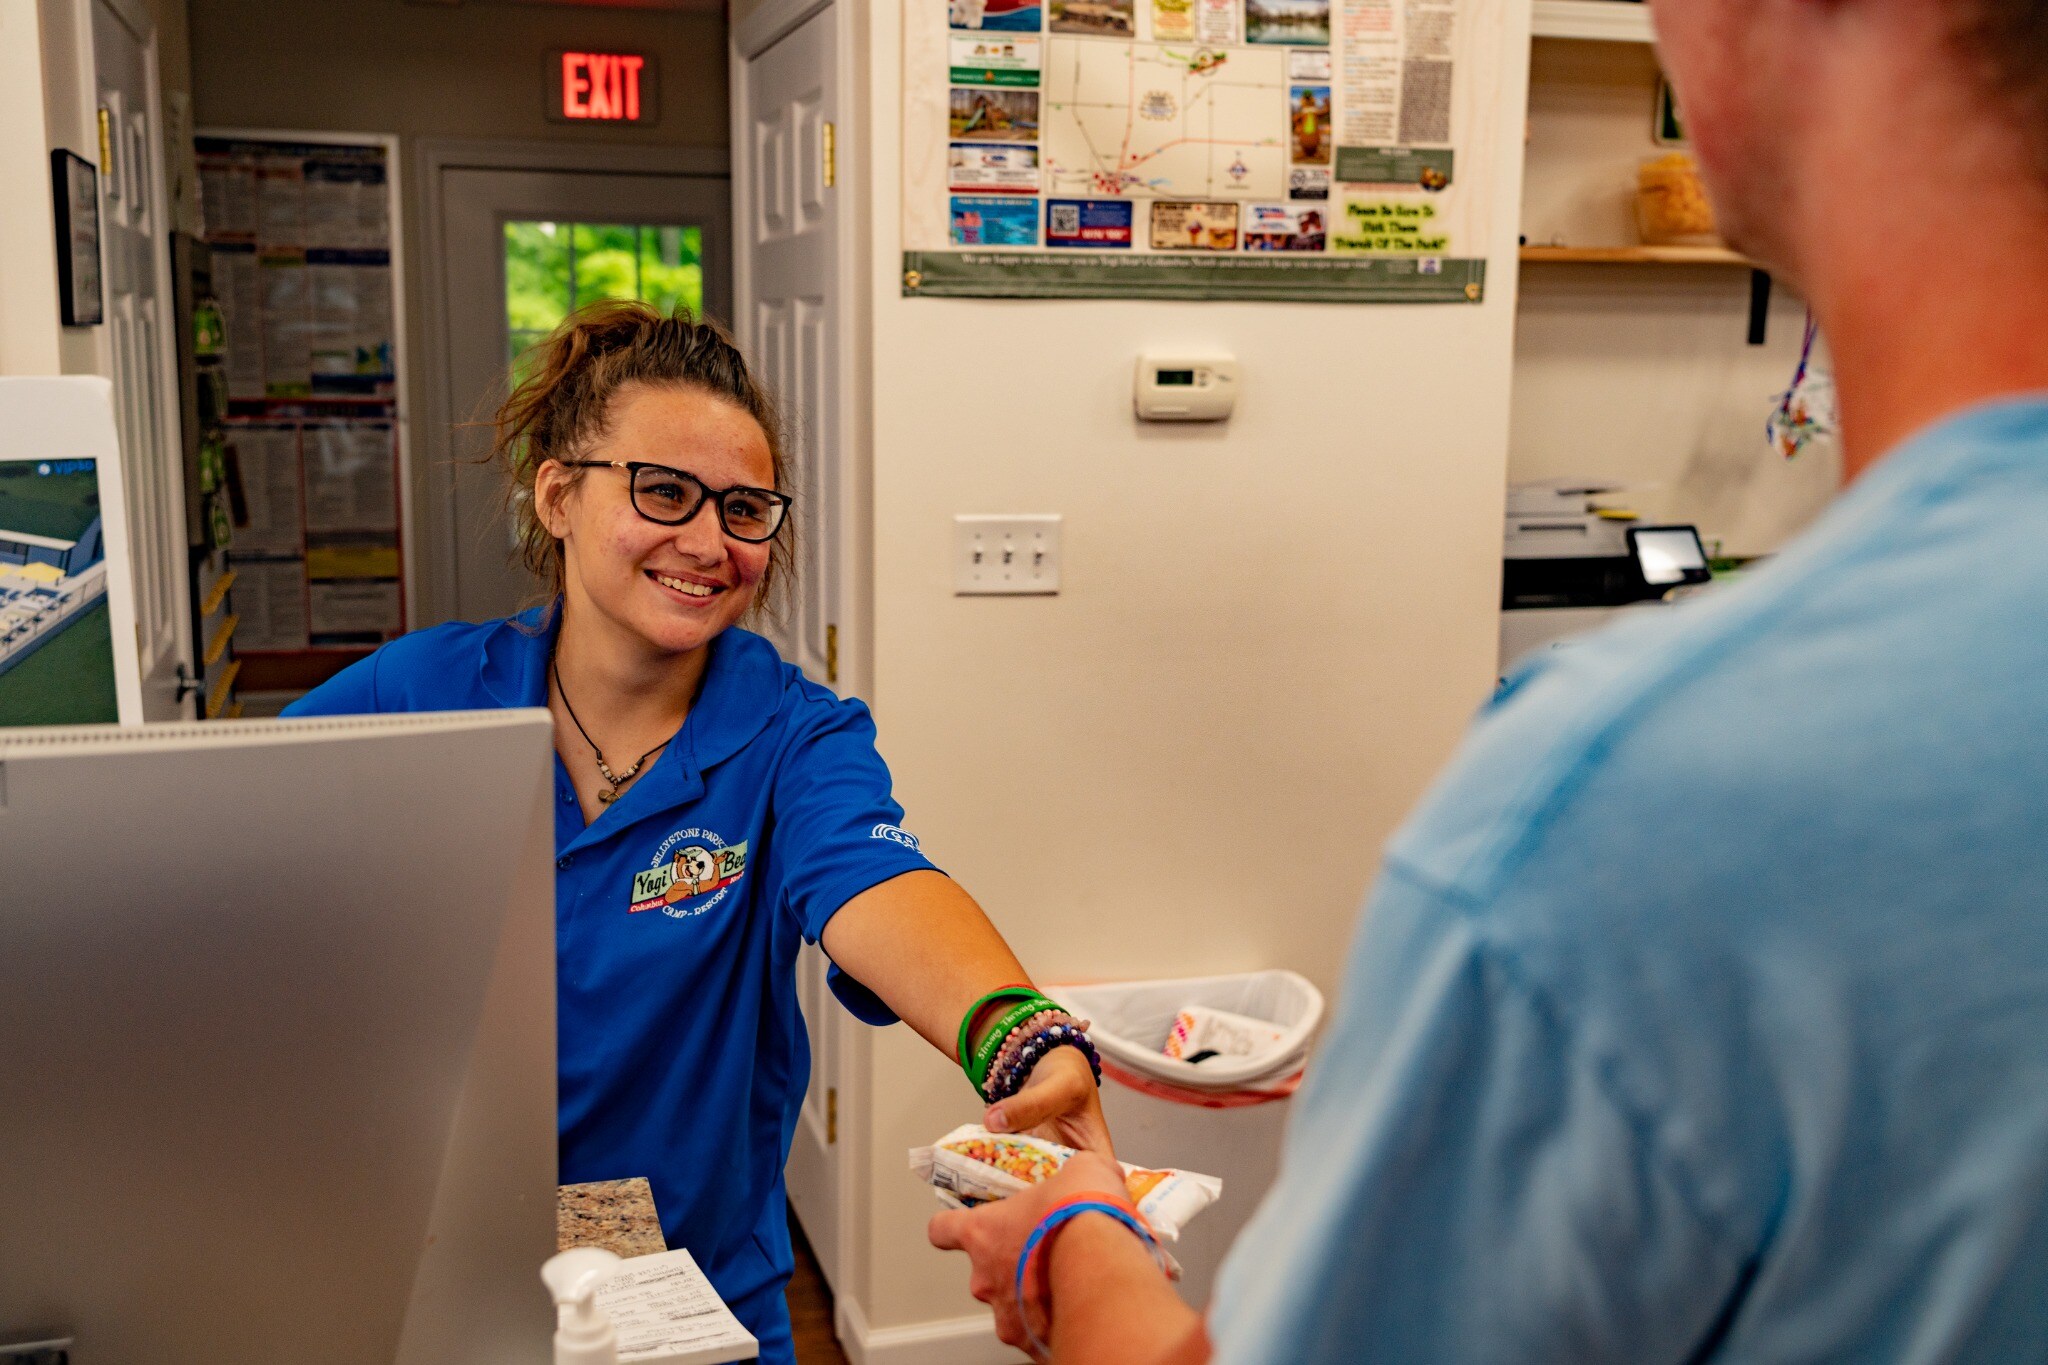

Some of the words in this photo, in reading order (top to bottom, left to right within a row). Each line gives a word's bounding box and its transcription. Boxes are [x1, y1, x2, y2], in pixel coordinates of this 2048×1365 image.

[562, 53, 643, 120] EXIT
[651, 828, 700, 868] JELLYSTONE
[637, 870, 667, 895] Yogi
[724, 851, 747, 873] Bea
[630, 899, 664, 912] Columbus
[978, 1028, 1002, 1060] Striving
